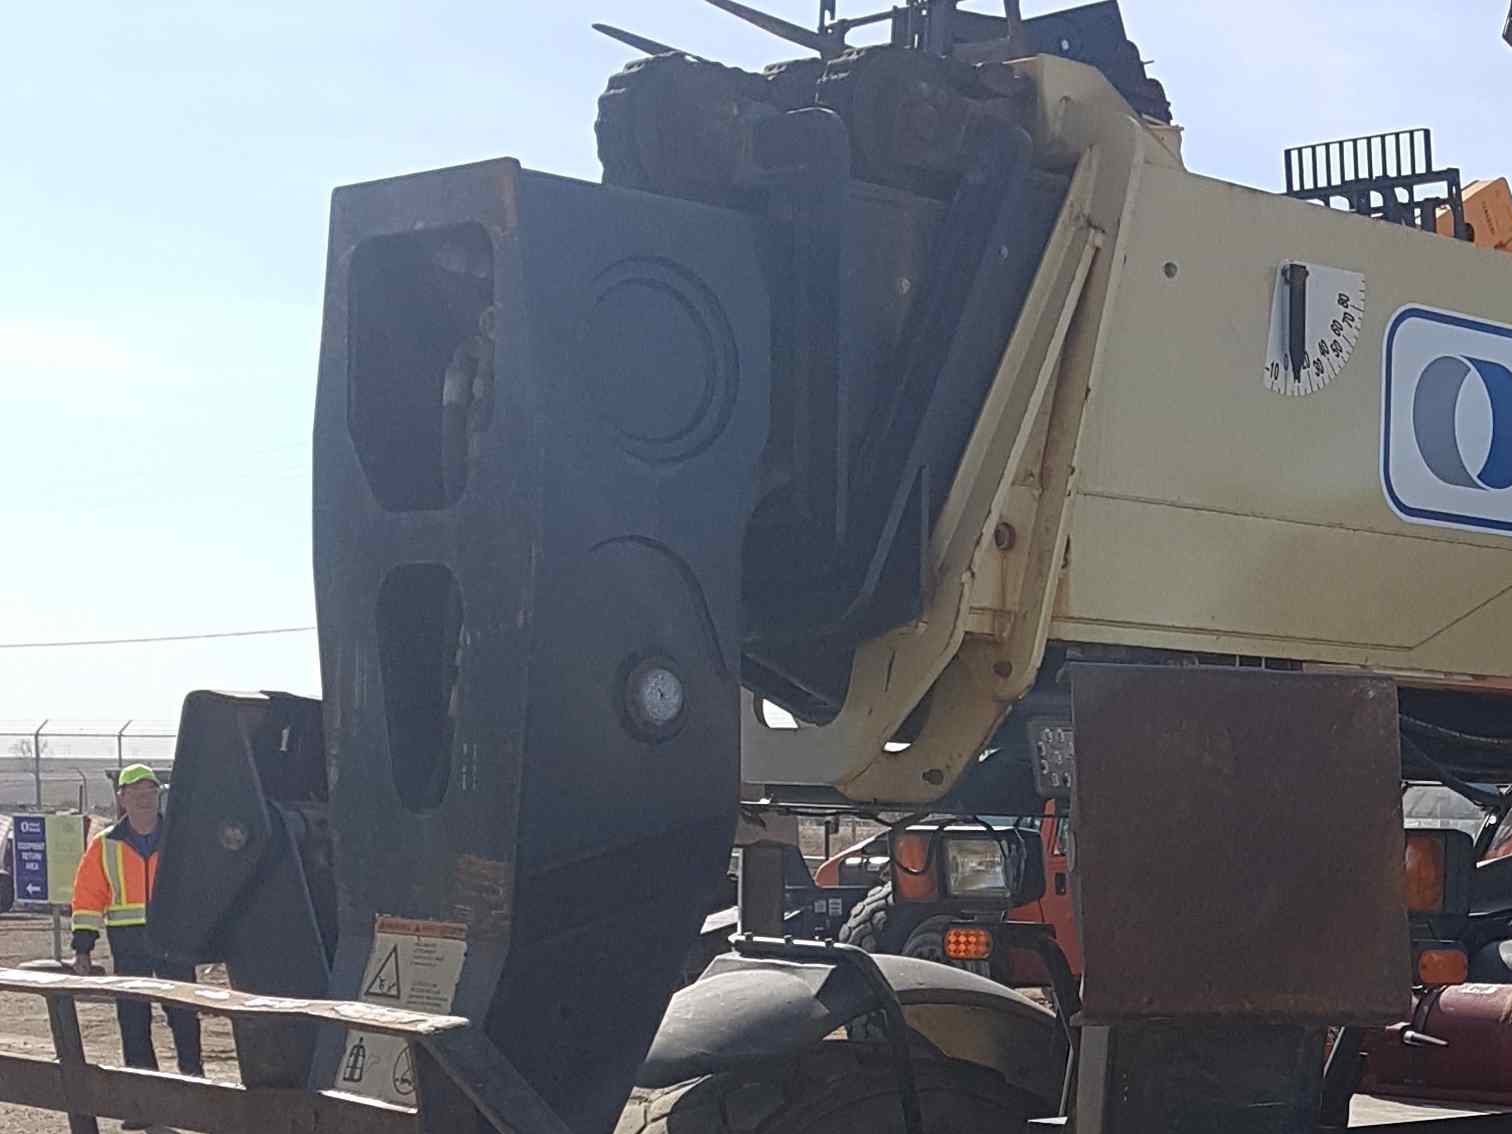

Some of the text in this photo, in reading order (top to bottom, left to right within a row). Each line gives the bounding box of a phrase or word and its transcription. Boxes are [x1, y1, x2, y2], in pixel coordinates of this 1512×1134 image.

[1337, 292, 1350, 309] 80
[1330, 319, 1344, 337] 60
[1342, 312, 1355, 328] 70
[1330, 339, 1343, 358] 50
[1313, 358, 1324, 377] 30
